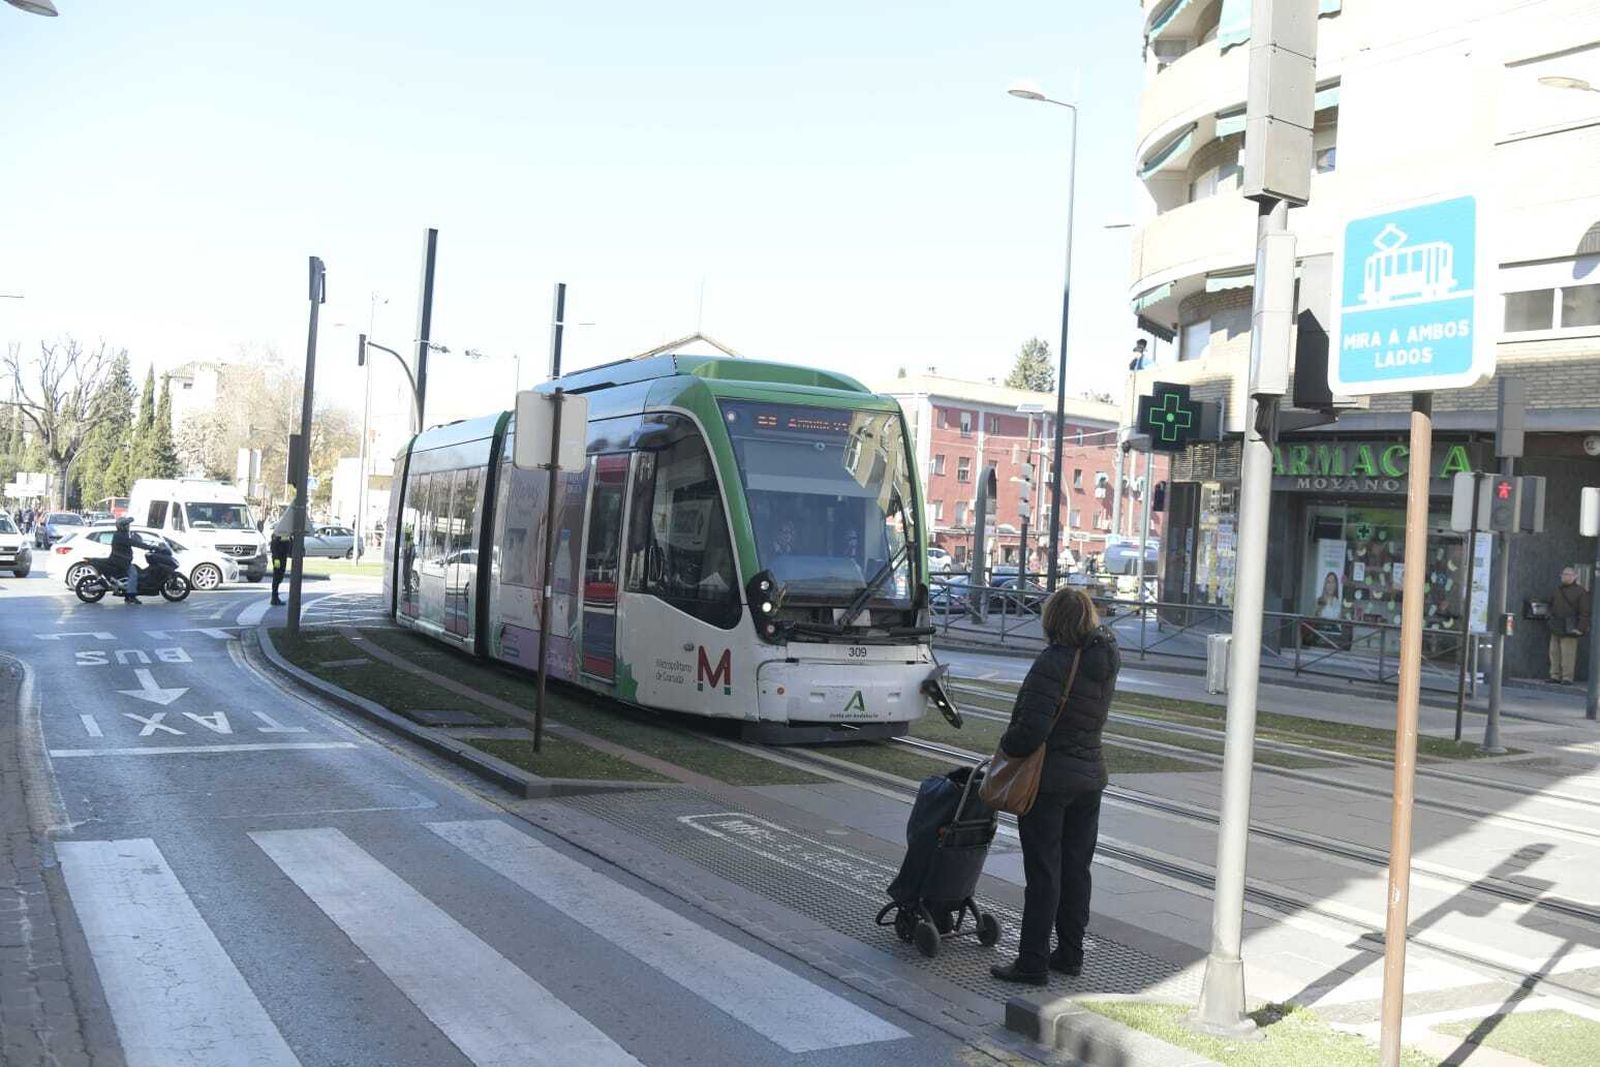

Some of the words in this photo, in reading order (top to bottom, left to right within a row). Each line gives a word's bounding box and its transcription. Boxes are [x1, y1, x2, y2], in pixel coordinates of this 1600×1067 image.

[1344, 330, 1382, 350] MIRA
[1388, 328, 1400, 345] A
[1406, 319, 1470, 344] AMBOS
[1375, 346, 1433, 369] LADOS
[1272, 443, 1472, 479] ARMACA
[1297, 477, 1400, 492] MOYANO
[75, 647, 194, 666] BUS
[848, 647, 868, 658] 309
[79, 710, 310, 737] TAXI
